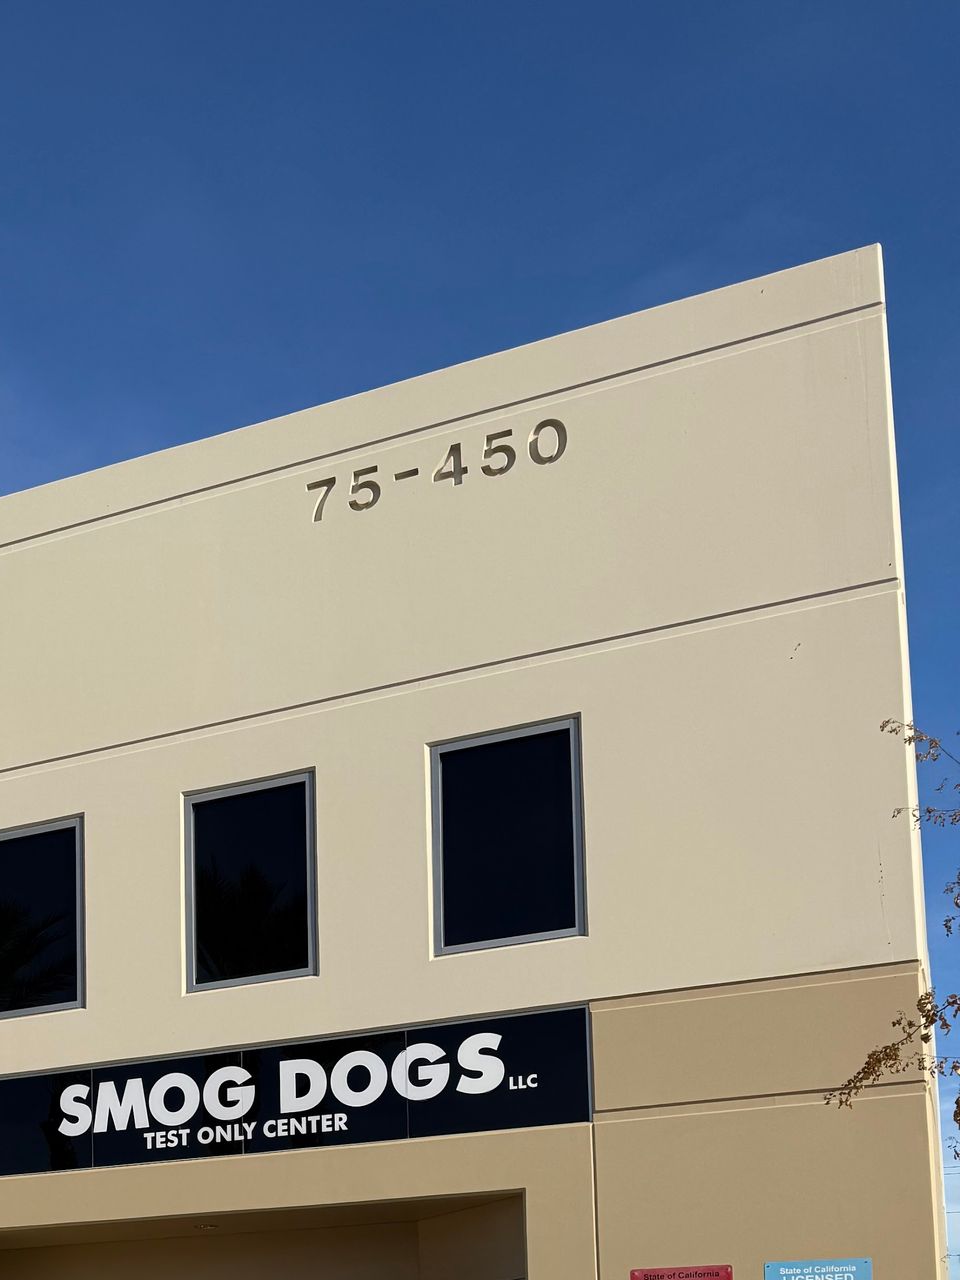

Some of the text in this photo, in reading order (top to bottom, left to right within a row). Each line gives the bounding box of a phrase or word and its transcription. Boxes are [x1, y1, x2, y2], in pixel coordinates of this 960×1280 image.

[306, 418, 568, 523] 75-450
[58, 1032, 538, 1137] SMOG DOGS LLC
[143, 1113, 348, 1150] TEST ONLY CENTER
[643, 1271, 720, 1280] State of California
[780, 1264, 856, 1275] State of California
